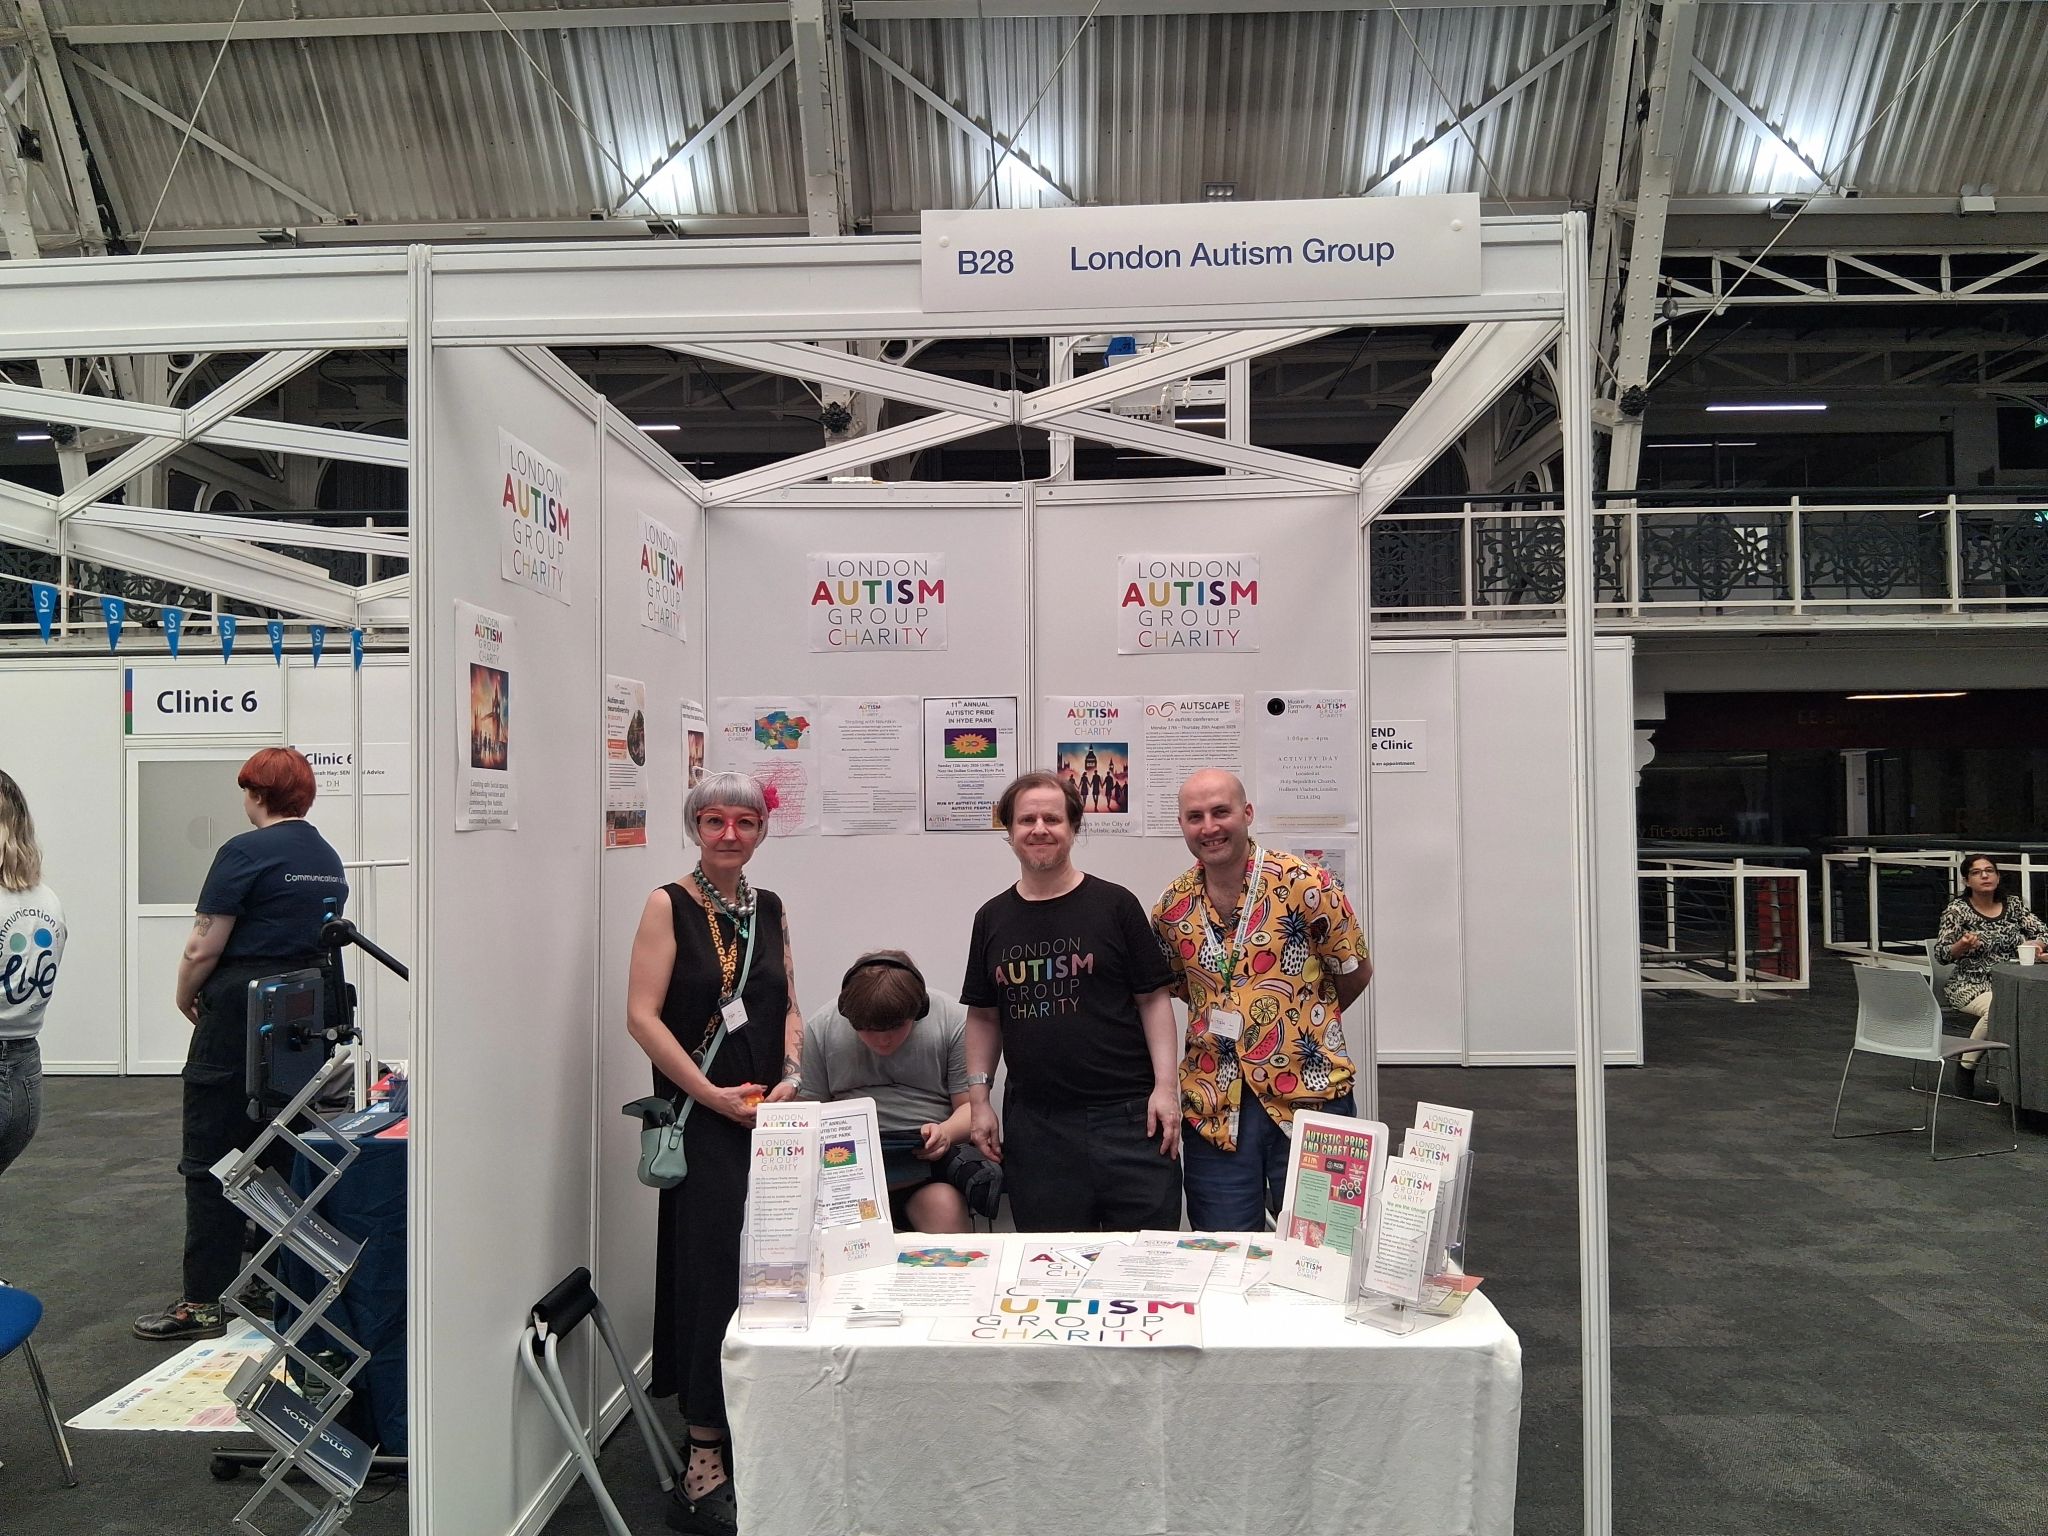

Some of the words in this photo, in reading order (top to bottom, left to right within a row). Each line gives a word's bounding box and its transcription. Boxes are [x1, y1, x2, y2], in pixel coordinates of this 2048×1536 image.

[957, 248, 1014, 276] B28
[1070, 245, 1181, 271] London
[1190, 240, 1293, 268] Autism
[1301, 237, 1395, 267] Group
[509, 444, 562, 497] LONDON
[502, 473, 570, 541] AUTISM
[512, 518, 564, 563] GROUP
[644, 524, 678, 557] LONDON
[513, 549, 564, 593] CHARITY
[641, 543, 684, 591] AUTISM
[826, 560, 928, 577] LONDON
[1138, 561, 1241, 579] LONDON
[646, 578, 681, 609] GROUP
[811, 579, 945, 605] AUTISM
[1121, 580, 1258, 607] AUTISM
[647, 601, 681, 633] CHARITY
[828, 607, 928, 625] GROUP
[1138, 609, 1241, 626] GROUP
[474, 623, 503, 644] AUTISM
[828, 627, 928, 645] CHARITY
[1138, 629, 1241, 648] CHARITY
[157, 689, 233, 713] Clinic
[241, 690, 258, 712] 6
[1073, 700, 1113, 708] LONDON
[1180, 701, 1230, 710] AUTSCAPE
[1067, 708, 1119, 719] AUTISM
[1074, 727, 1112, 736] CHARITY
[1371, 727, 1396, 737] END
[1380, 739, 1413, 750] Clinic
[305, 752, 343, 765] Clinic
[284, 873, 339, 883] Communication
[1002, 937, 1081, 962] LONDON
[995, 952, 1094, 986] AUTISM
[1006, 978, 1080, 1001] GROUP
[1009, 996, 1080, 1019] CHARITY
[1423, 1120, 1463, 1137] AUTISM
[1429, 1115, 1460, 1126] LONDON
[762, 1139, 799, 1147] LONDON
[1305, 1129, 1342, 1145] AUTISTIC
[1344, 1135, 1369, 1150] PRIDE
[1415, 1140, 1447, 1151] LONDON
[755, 1146, 805, 1157] AUTISM
[1302, 1140, 1319, 1153] AND
[1321, 1144, 1348, 1156] CRAFT
[1350, 1147, 1369, 1161] FAIR
[1409, 1146, 1450, 1162] AUTISM
[760, 1164, 798, 1172] CHARITY
[761, 1156, 799, 1164] GROUP
[1390, 1174, 1432, 1191] AUTISM
[1396, 1169, 1429, 1180] LONDON
[843, 1241, 871, 1253] AUTISM
[1295, 1259, 1323, 1272] AUTISM
[1000, 1297, 1195, 1315] UTISM
[976, 1314, 1165, 1328] GROUP
[971, 1327, 1164, 1342] CHARITY
[282, 1404, 353, 1459] Smatbox
